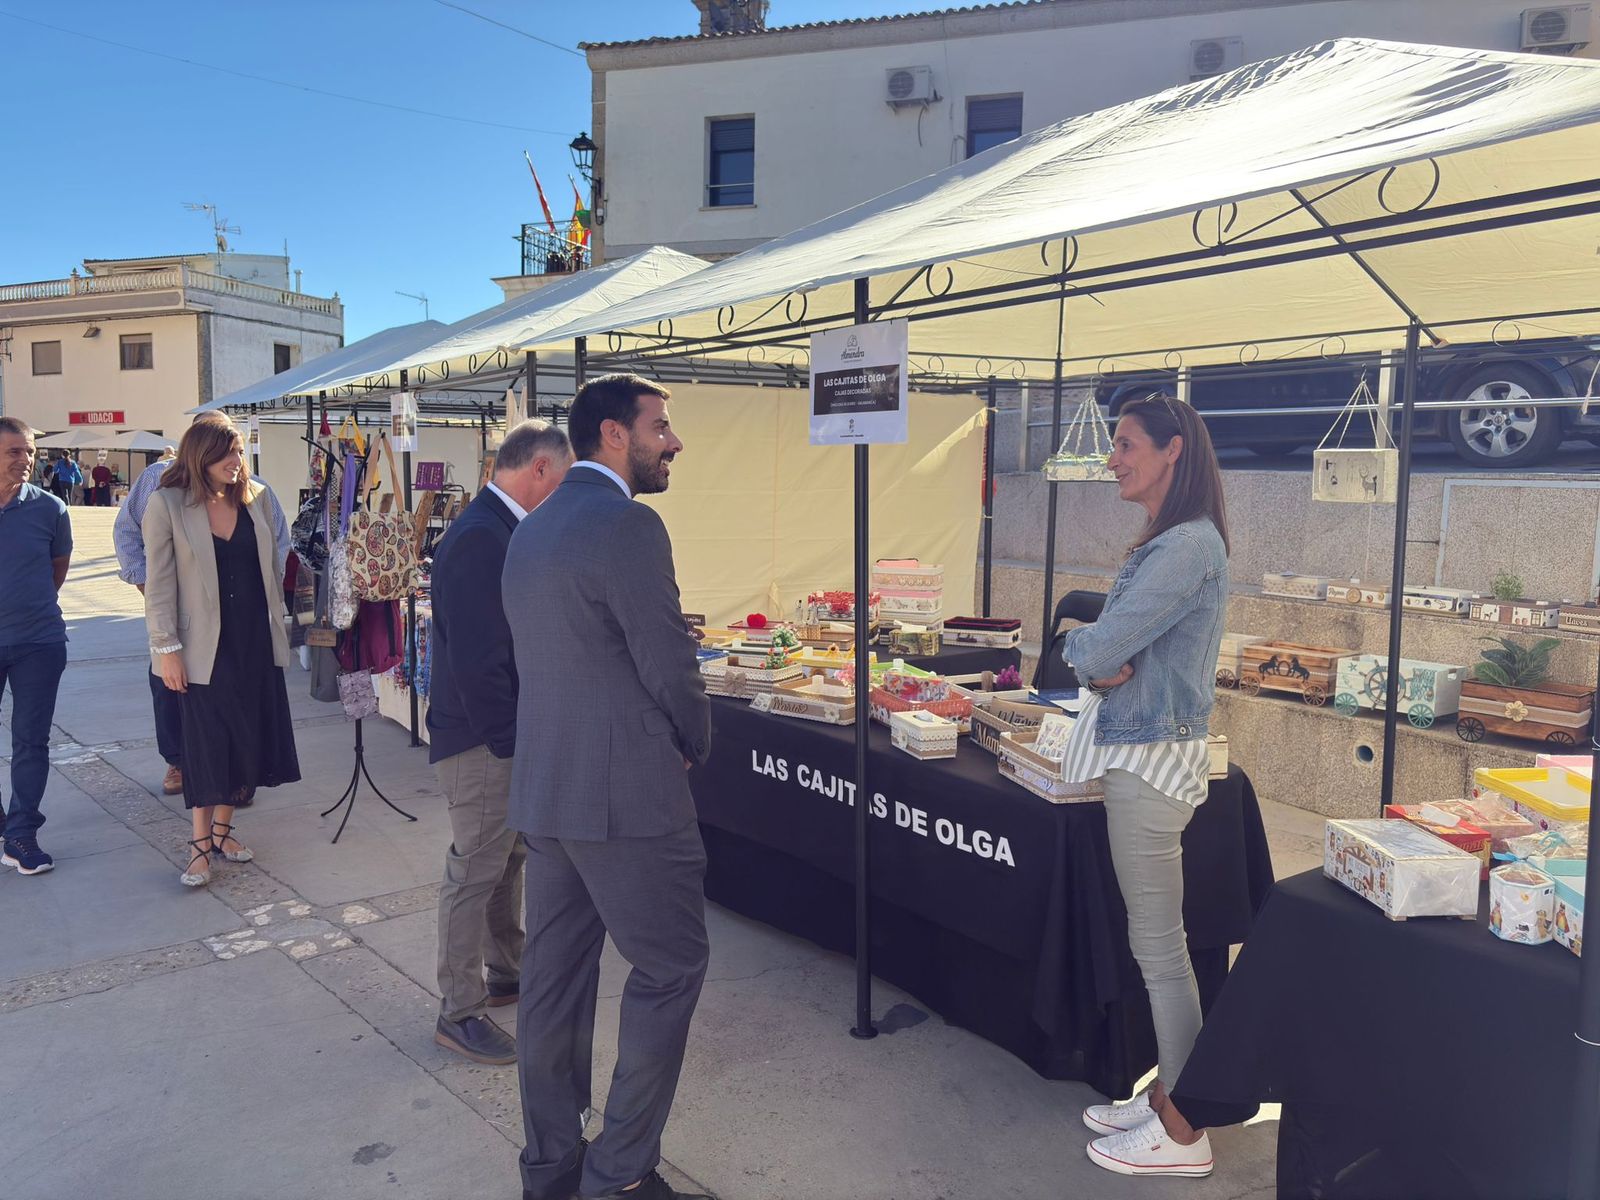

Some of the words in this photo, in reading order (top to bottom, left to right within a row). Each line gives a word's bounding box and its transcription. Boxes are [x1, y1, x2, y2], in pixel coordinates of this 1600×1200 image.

[823, 378, 833, 387] LAS
[833, 376, 858, 386] CAJITAS
[858, 375, 867, 384] DE
[867, 373, 886, 383] OLGA
[87, 412, 114, 423] UDACO
[975, 722, 1000, 754] Mam
[752, 749, 789, 782] LAS
[797, 764, 888, 818] CAJITS
[895, 801, 928, 837] DE
[935, 818, 1016, 868] OLGA
